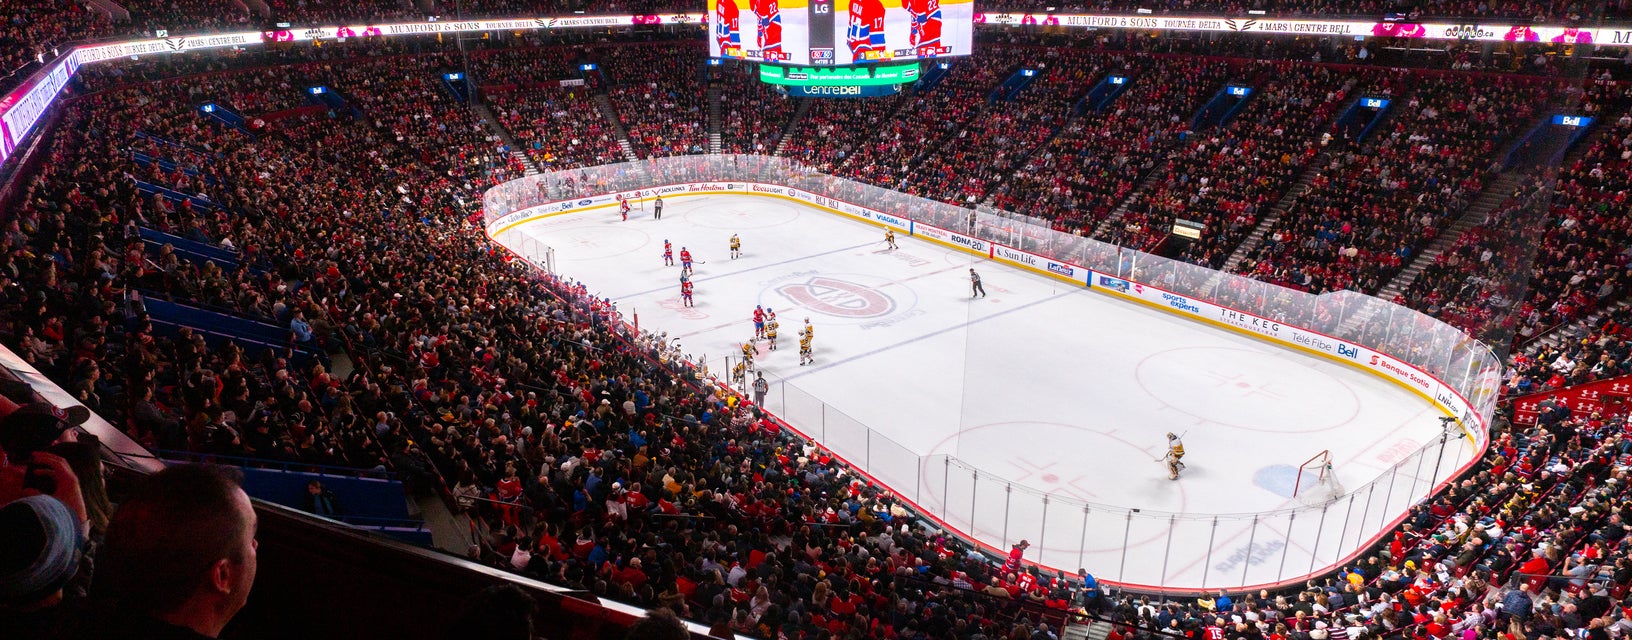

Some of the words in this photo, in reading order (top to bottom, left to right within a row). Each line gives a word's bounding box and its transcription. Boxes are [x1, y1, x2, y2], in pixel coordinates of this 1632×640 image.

[769, 3, 777, 15] 22
[814, 4, 829, 14] LG
[390, 23, 441, 34] MUMFORD
[454, 22, 480, 30] SONS
[732, 18, 738, 29] 17
[874, 17, 883, 29] 17
[1067, 16, 1117, 27] MUMFORD
[1130, 18, 1158, 28] SONS
[1199, 20, 1221, 29] DELTA
[1264, 23, 1288, 31] MARS
[1294, 23, 1328, 33] CENTRE
[1329, 24, 1351, 34] BELL
[1233, 87, 1245, 95] Bell
[1368, 99, 1381, 107] Bell
[1562, 116, 1581, 126] Bell
[688, 184, 700, 192] Tim
[700, 183, 725, 191] Hortons
[752, 184, 770, 192] Coors
[769, 186, 783, 194] LIGHT
[561, 202, 574, 210] Bell
[951, 234, 971, 246] RONA
[1004, 249, 1019, 261] Sun
[1020, 254, 1036, 266] Life
[1162, 292, 1187, 305] sports
[1170, 300, 1200, 314] experts
[1221, 309, 1245, 322] THE
[1252, 317, 1279, 332] KEG
[1292, 332, 1311, 345] Télé
[1312, 338, 1332, 352] Fibe
[1337, 343, 1358, 359] Bell
[1381, 360, 1409, 378] Banque
[1410, 373, 1430, 389] Scotia
[1211, 630, 1223, 640] 15
